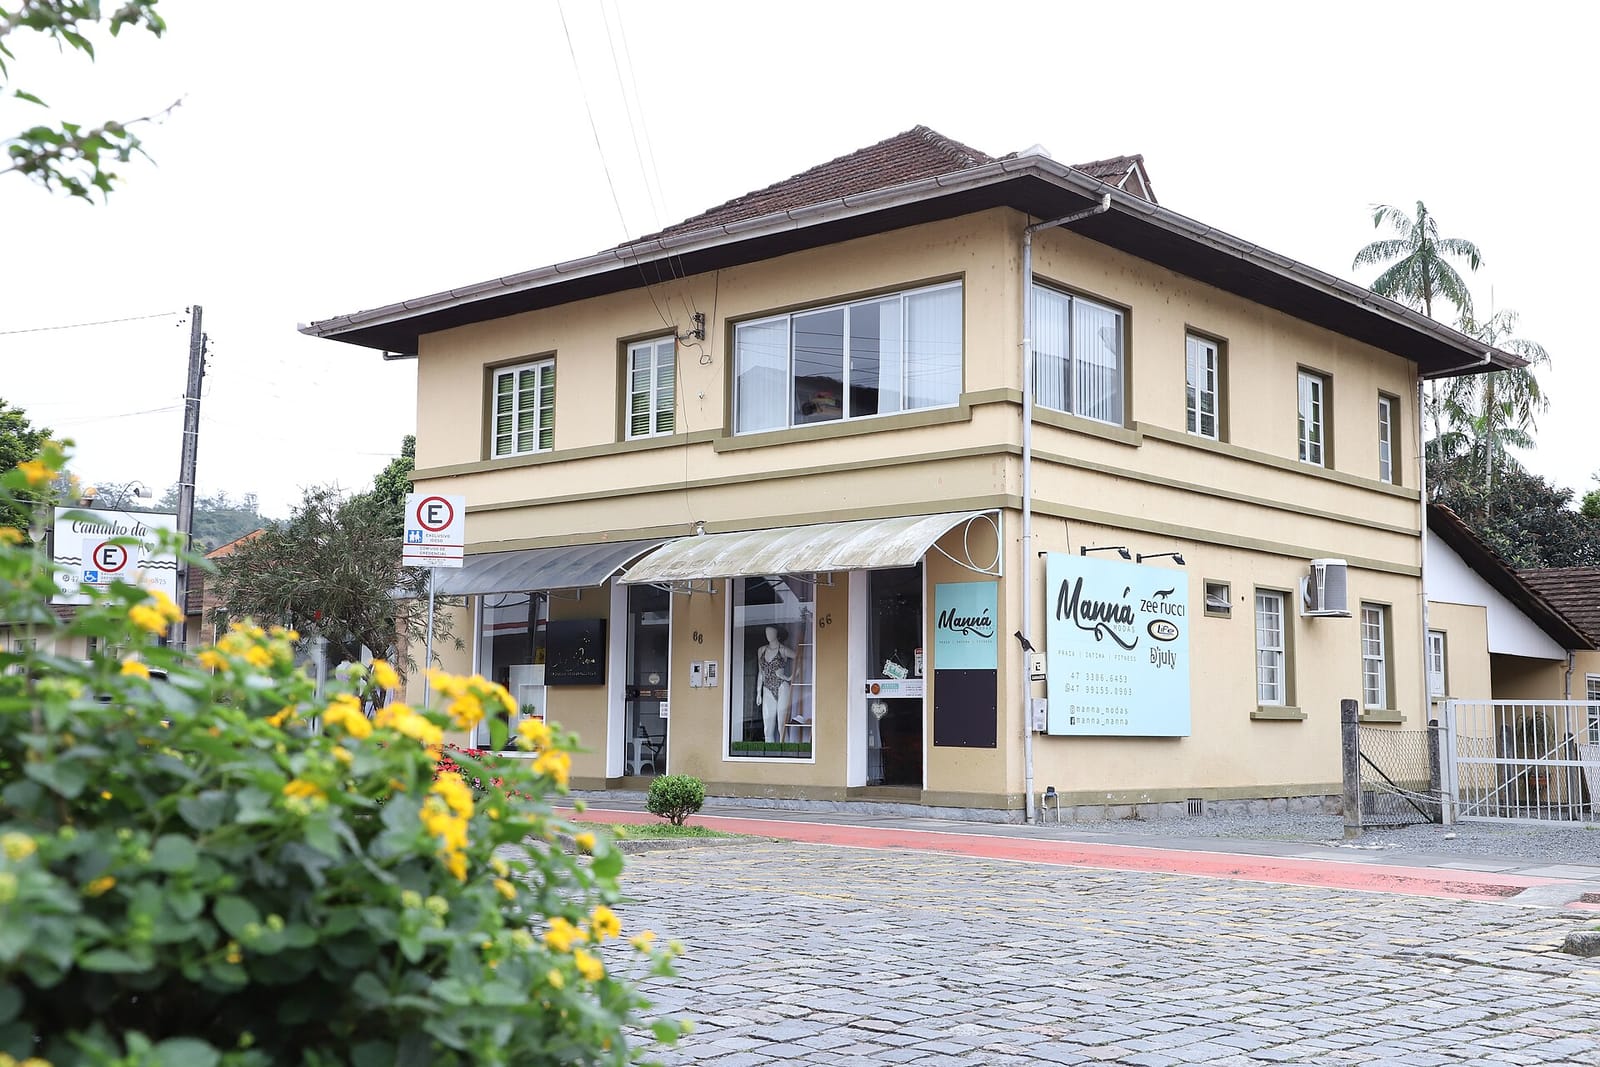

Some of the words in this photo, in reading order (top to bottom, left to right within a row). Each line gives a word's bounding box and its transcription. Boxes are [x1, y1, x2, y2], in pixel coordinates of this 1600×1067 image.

[428, 505, 442, 523] E
[130, 521, 148, 537] da
[103, 549, 117, 565] E
[819, 613, 832, 628] 66
[1056, 577, 1139, 650] Manná
[938, 608, 994, 638] Manná
